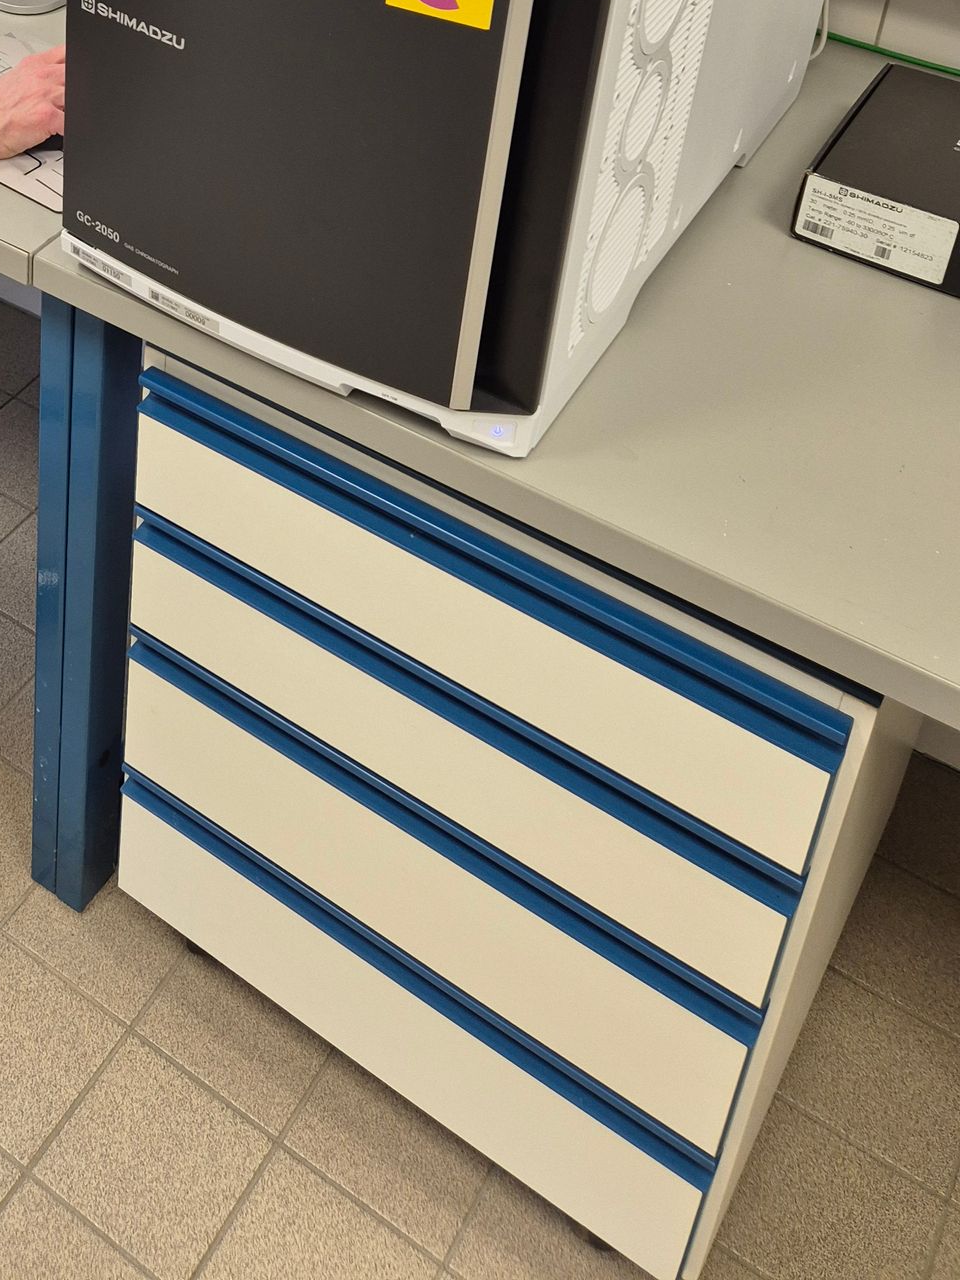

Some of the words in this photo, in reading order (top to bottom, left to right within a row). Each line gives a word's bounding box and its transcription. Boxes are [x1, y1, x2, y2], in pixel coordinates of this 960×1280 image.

[96, 2, 185, 50] SHIMADZU
[849, 192, 904, 213] SHIMADZU
[76, 210, 120, 243] GC-2050
[135, 248, 179, 275] CHROMATOGRAPH
